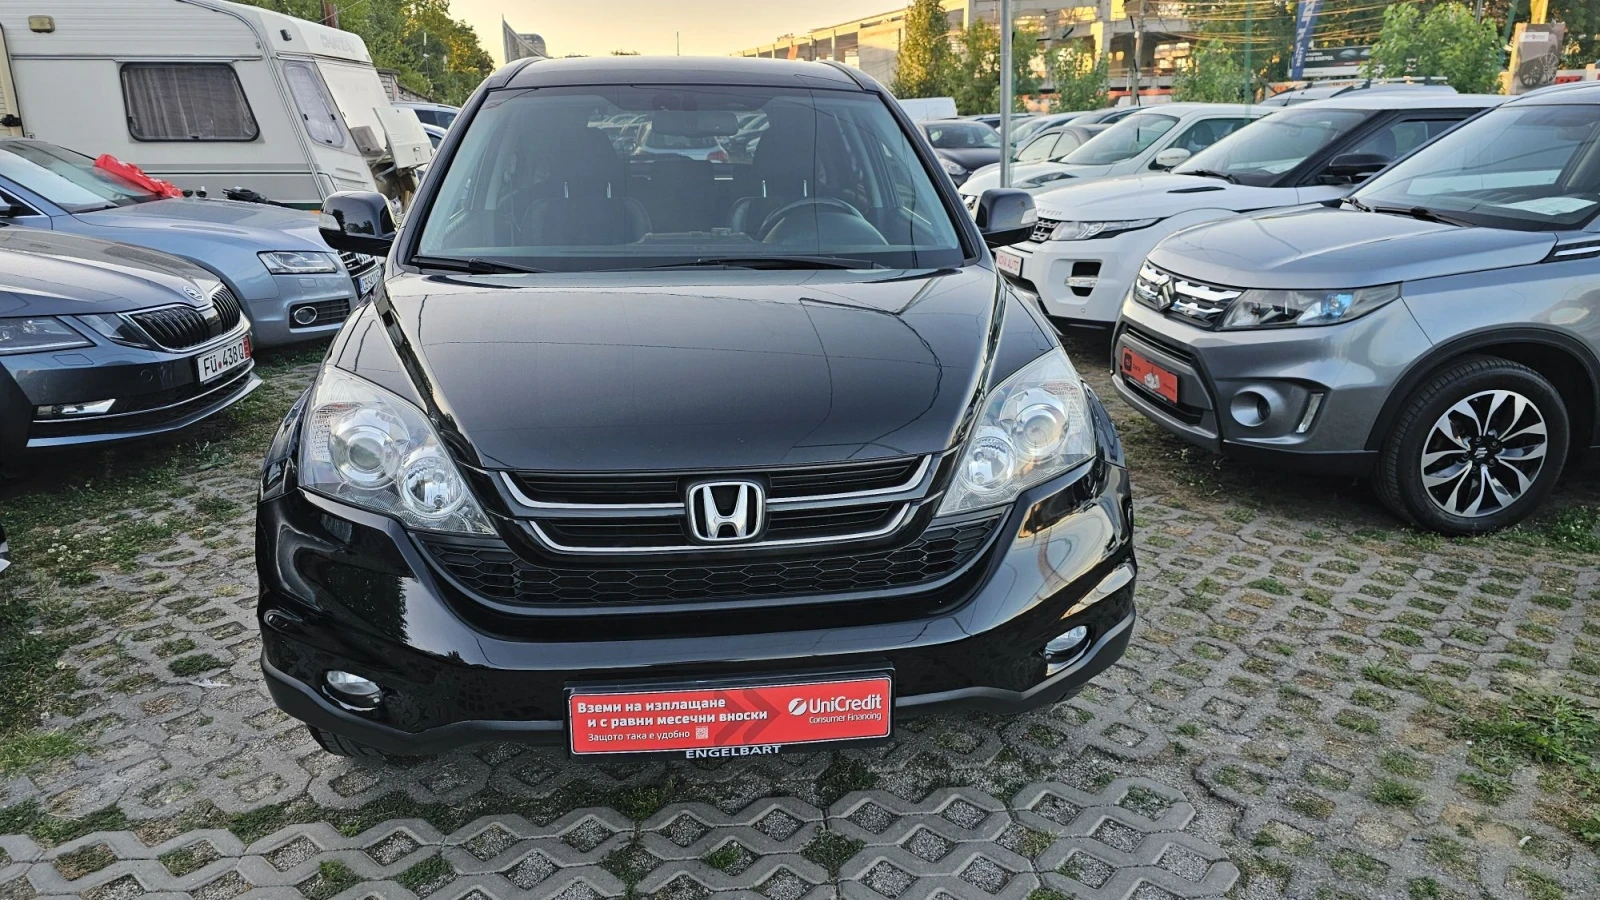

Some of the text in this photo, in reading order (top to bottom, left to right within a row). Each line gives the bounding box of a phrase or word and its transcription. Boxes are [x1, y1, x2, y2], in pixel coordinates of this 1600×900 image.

[578, 699, 726, 713] Вземи на изплащане
[809, 694, 882, 714] UniCredit
[587, 711, 768, 729] и с равни месечни вноски
[809, 712, 882, 724] Consumer Financing
[588, 731, 624, 742] Защото
[627, 731, 647, 740] така
[656, 730, 690, 742] удобно
[685, 745, 782, 759] ENGELBART
